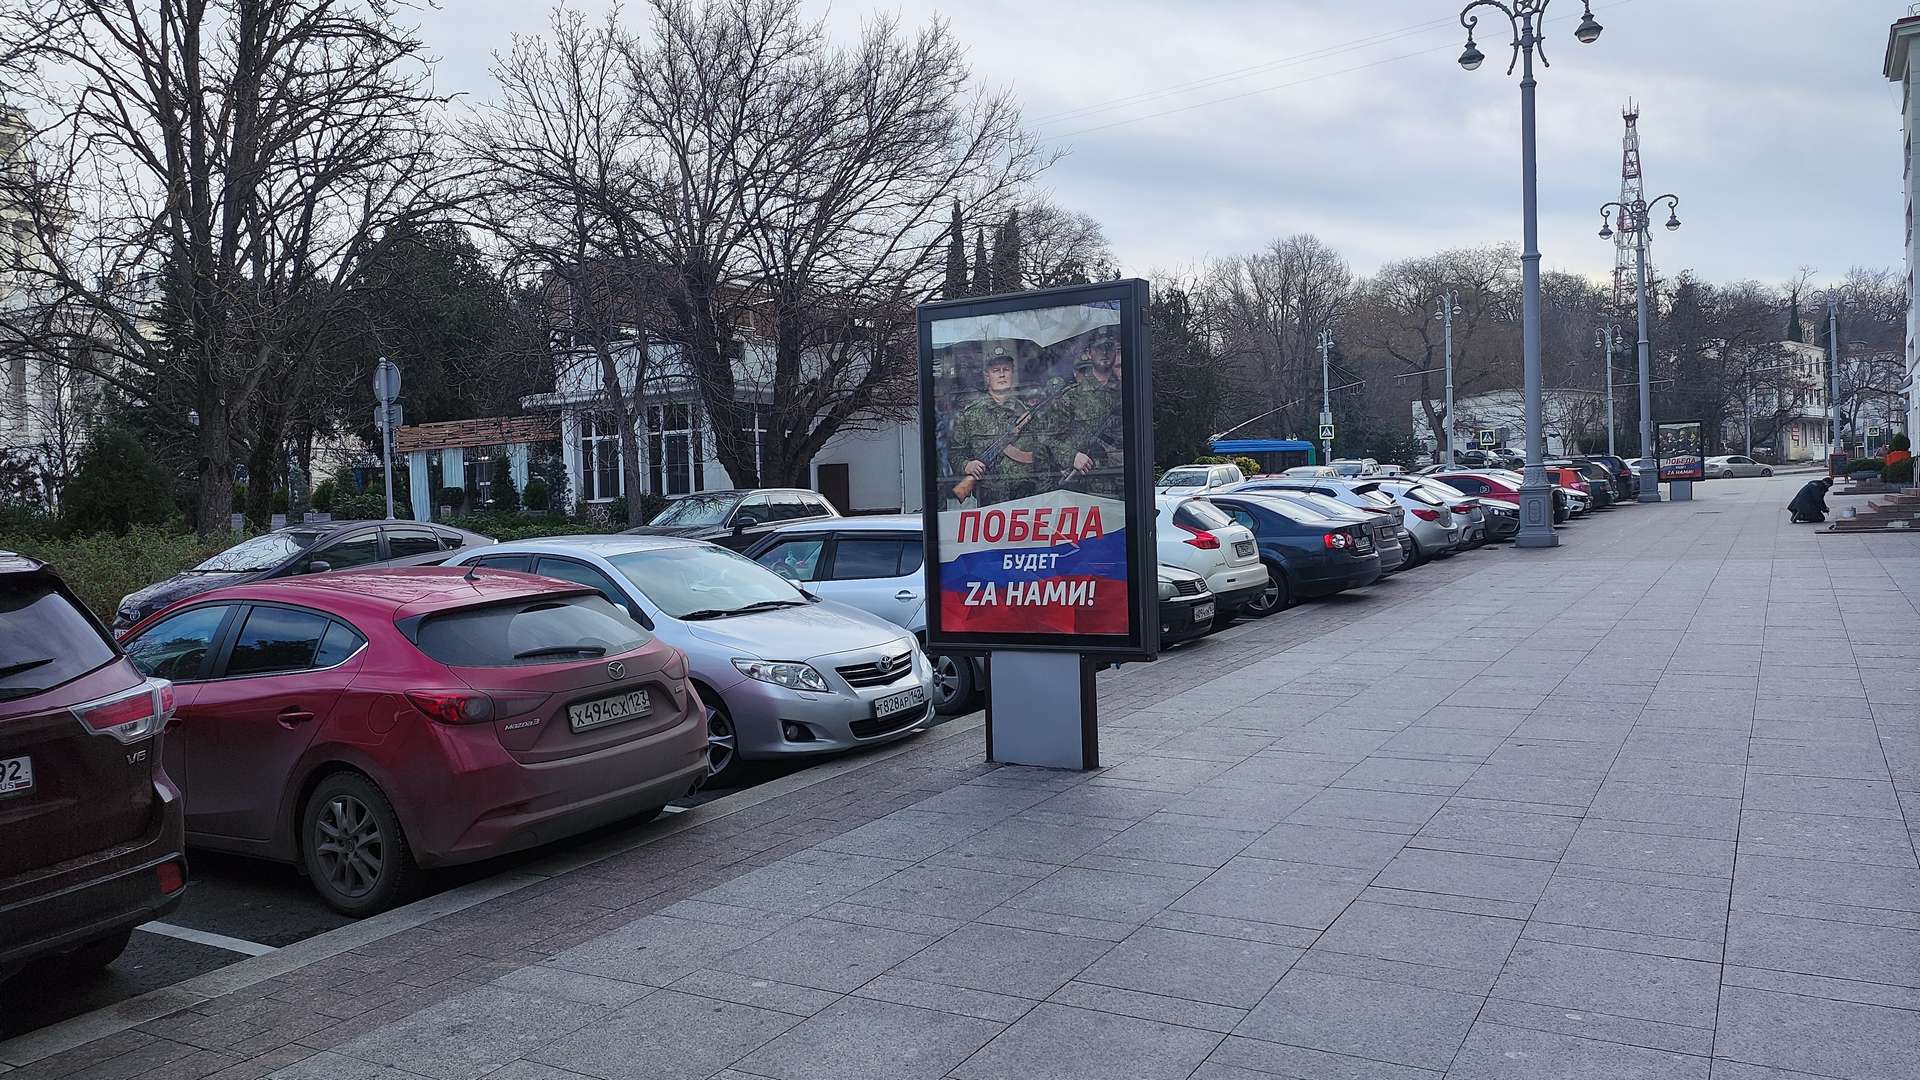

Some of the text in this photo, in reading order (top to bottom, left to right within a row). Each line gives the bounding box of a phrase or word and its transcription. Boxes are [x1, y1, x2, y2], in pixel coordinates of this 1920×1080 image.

[957, 506, 1105, 547] ПОБЕДА
[1002, 553, 1060, 572] БУДЕТ
[1006, 580, 1096, 607] НАМИ!
[629, 691, 647, 707] 123
[126, 749, 147, 765] V6
